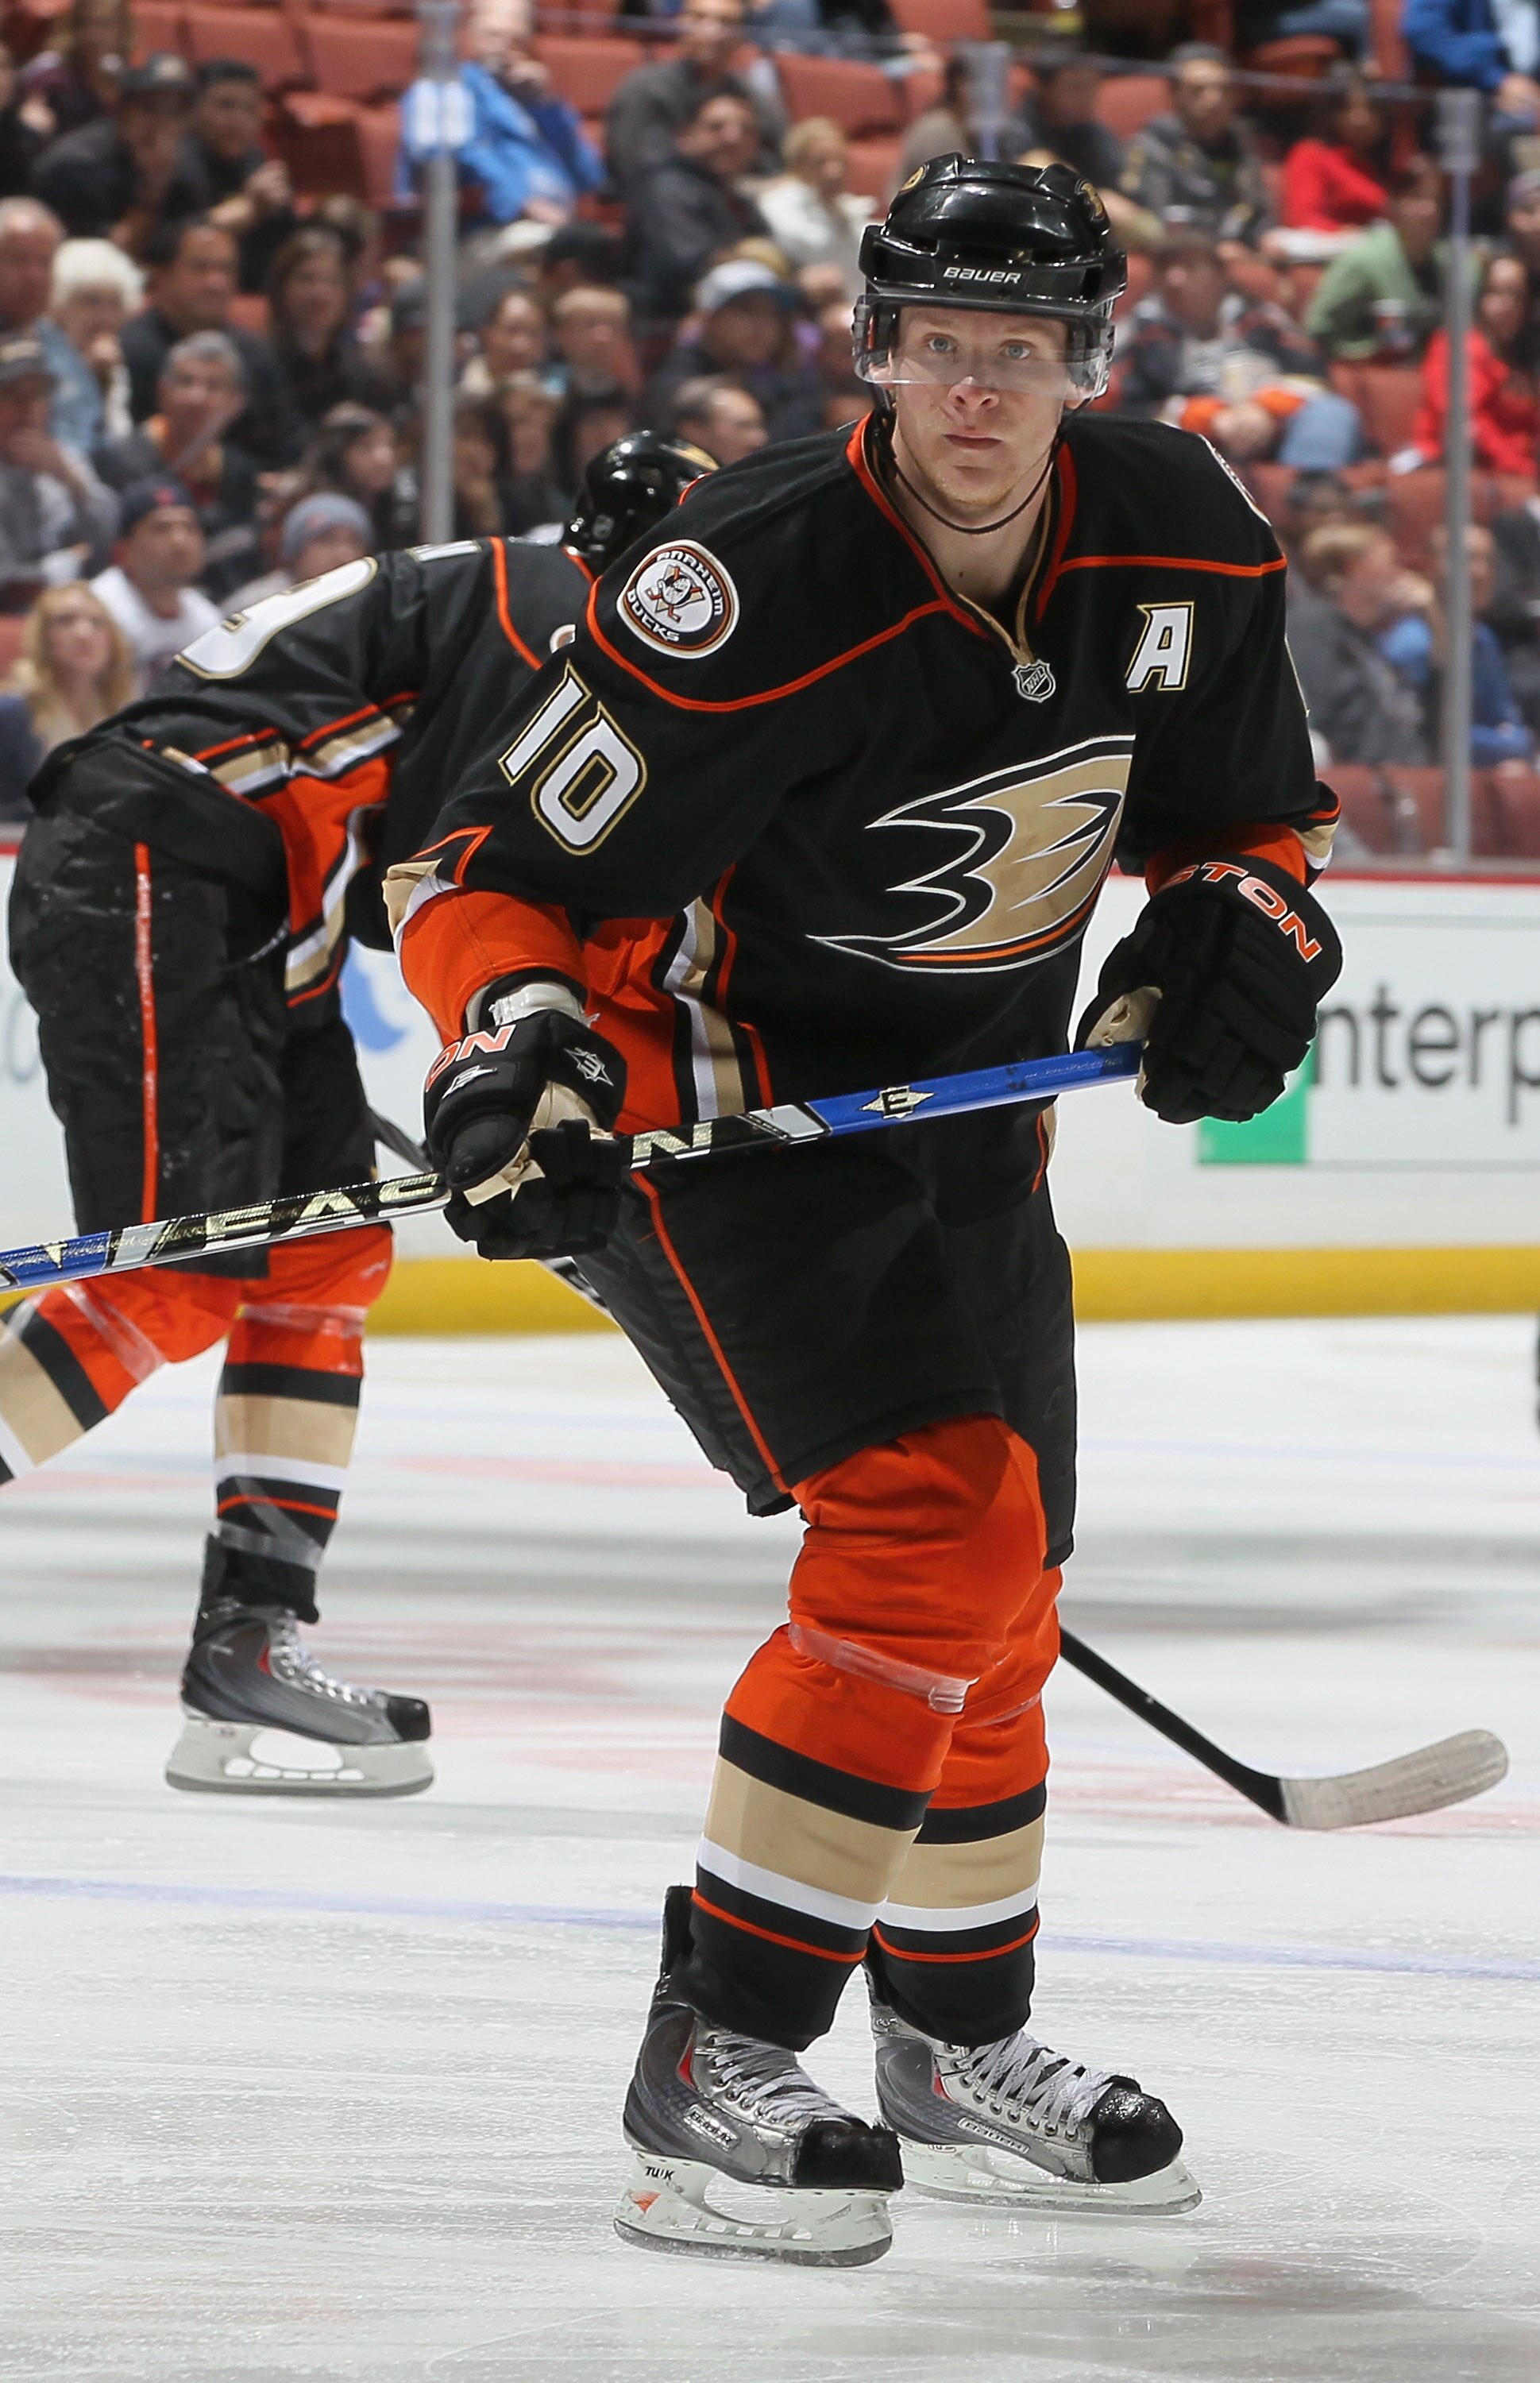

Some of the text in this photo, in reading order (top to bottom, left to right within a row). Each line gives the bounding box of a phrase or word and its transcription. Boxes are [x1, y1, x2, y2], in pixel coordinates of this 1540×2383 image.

[943, 266, 1021, 284] BAUER
[656, 550, 724, 616] ANAHEIM
[627, 589, 680, 642] DUCKS
[1124, 601, 1195, 693] A
[1024, 666, 1047, 693] NHL
[498, 659, 647, 855] 10
